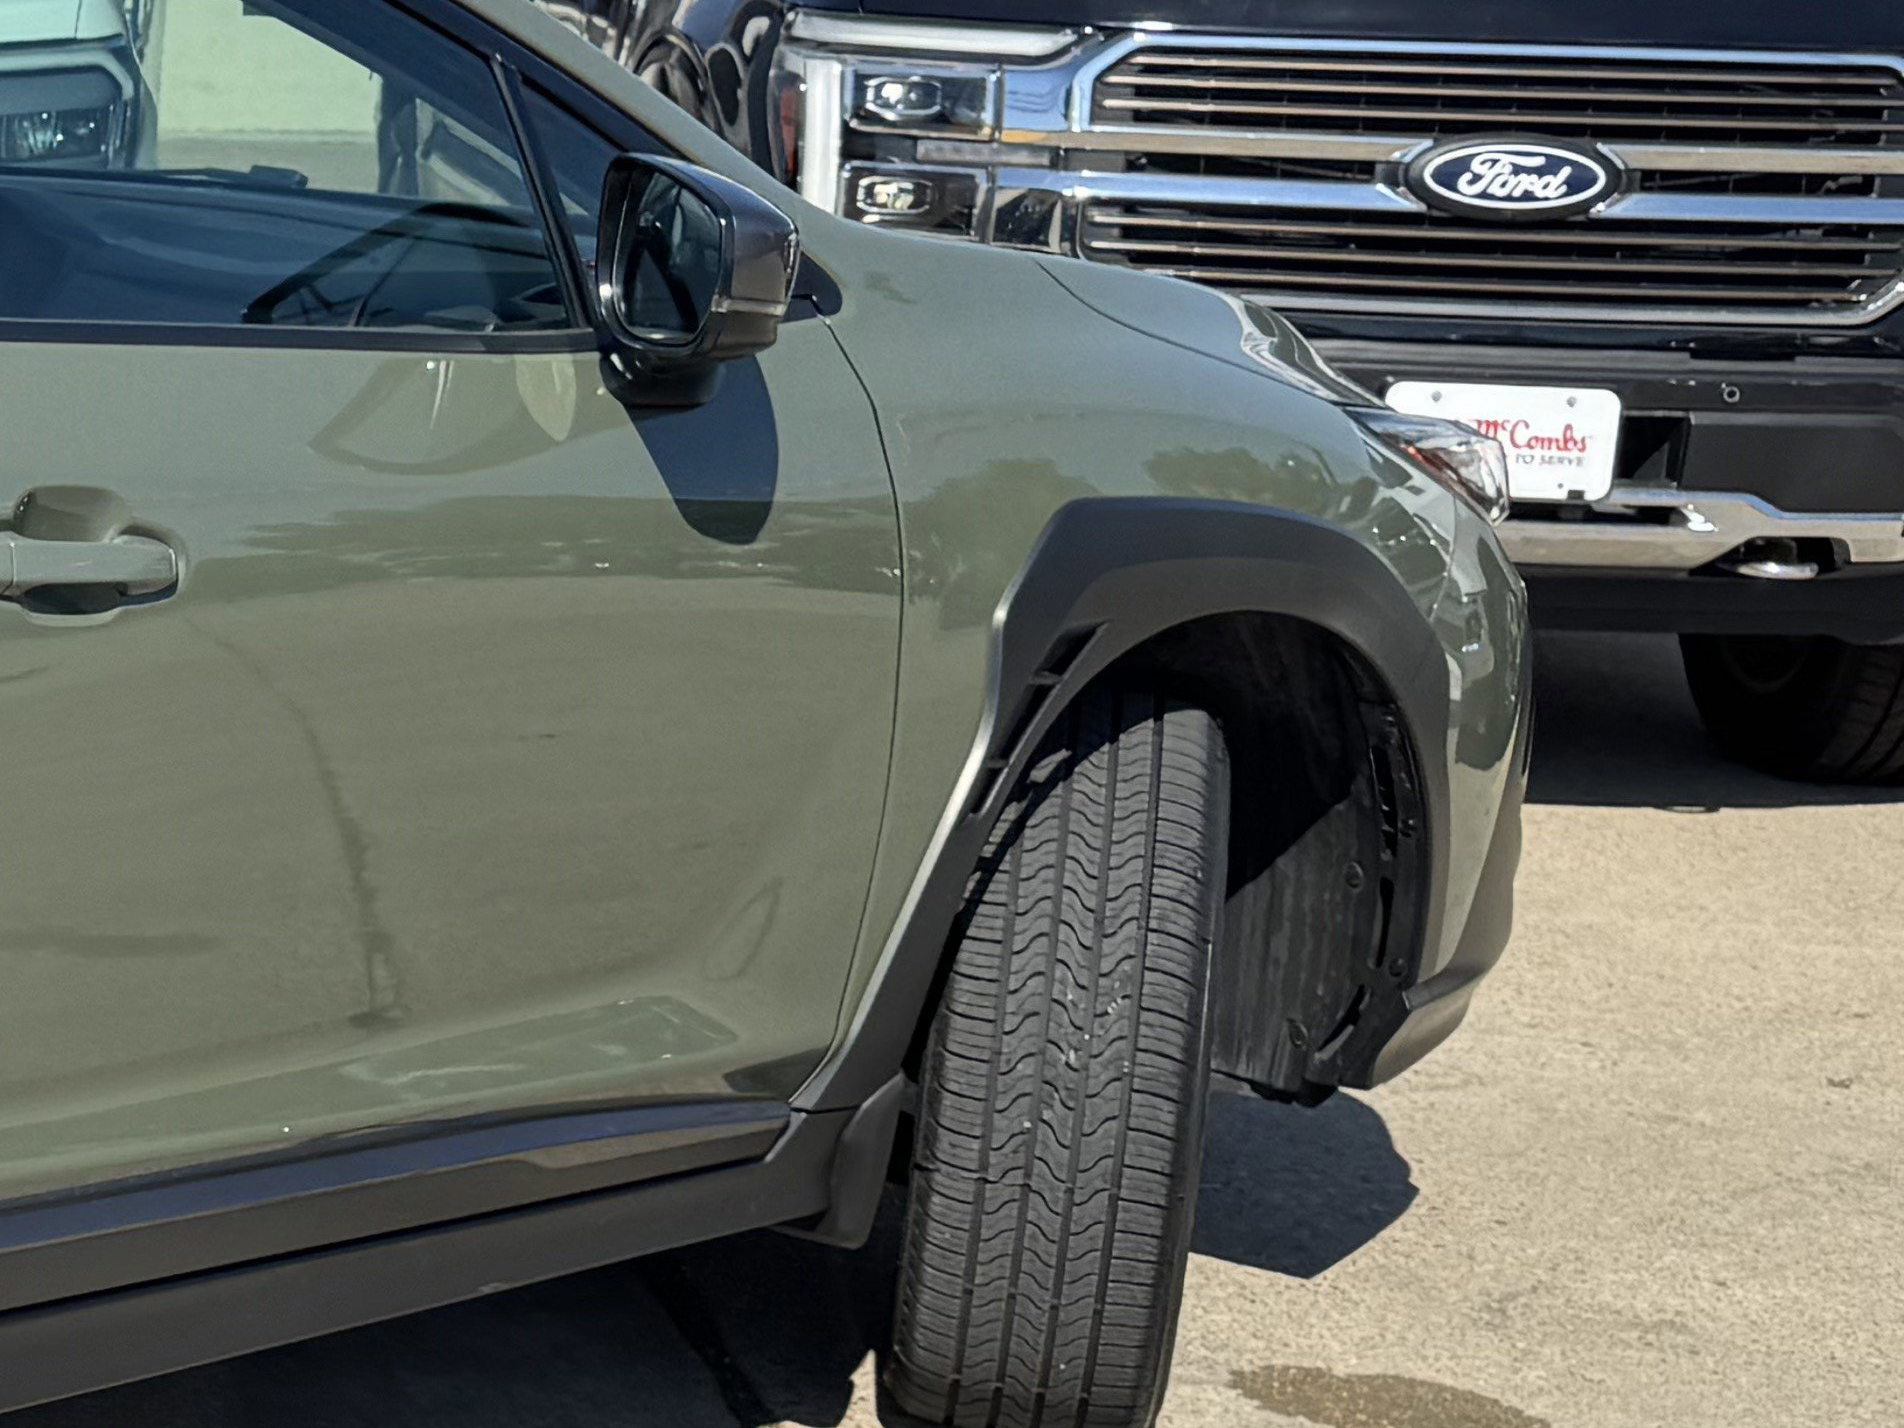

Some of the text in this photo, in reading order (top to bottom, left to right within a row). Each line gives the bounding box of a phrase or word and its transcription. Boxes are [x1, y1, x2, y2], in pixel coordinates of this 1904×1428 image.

[1456, 151, 1572, 199] Ford
[1515, 453, 1586, 468] TO SERVE
